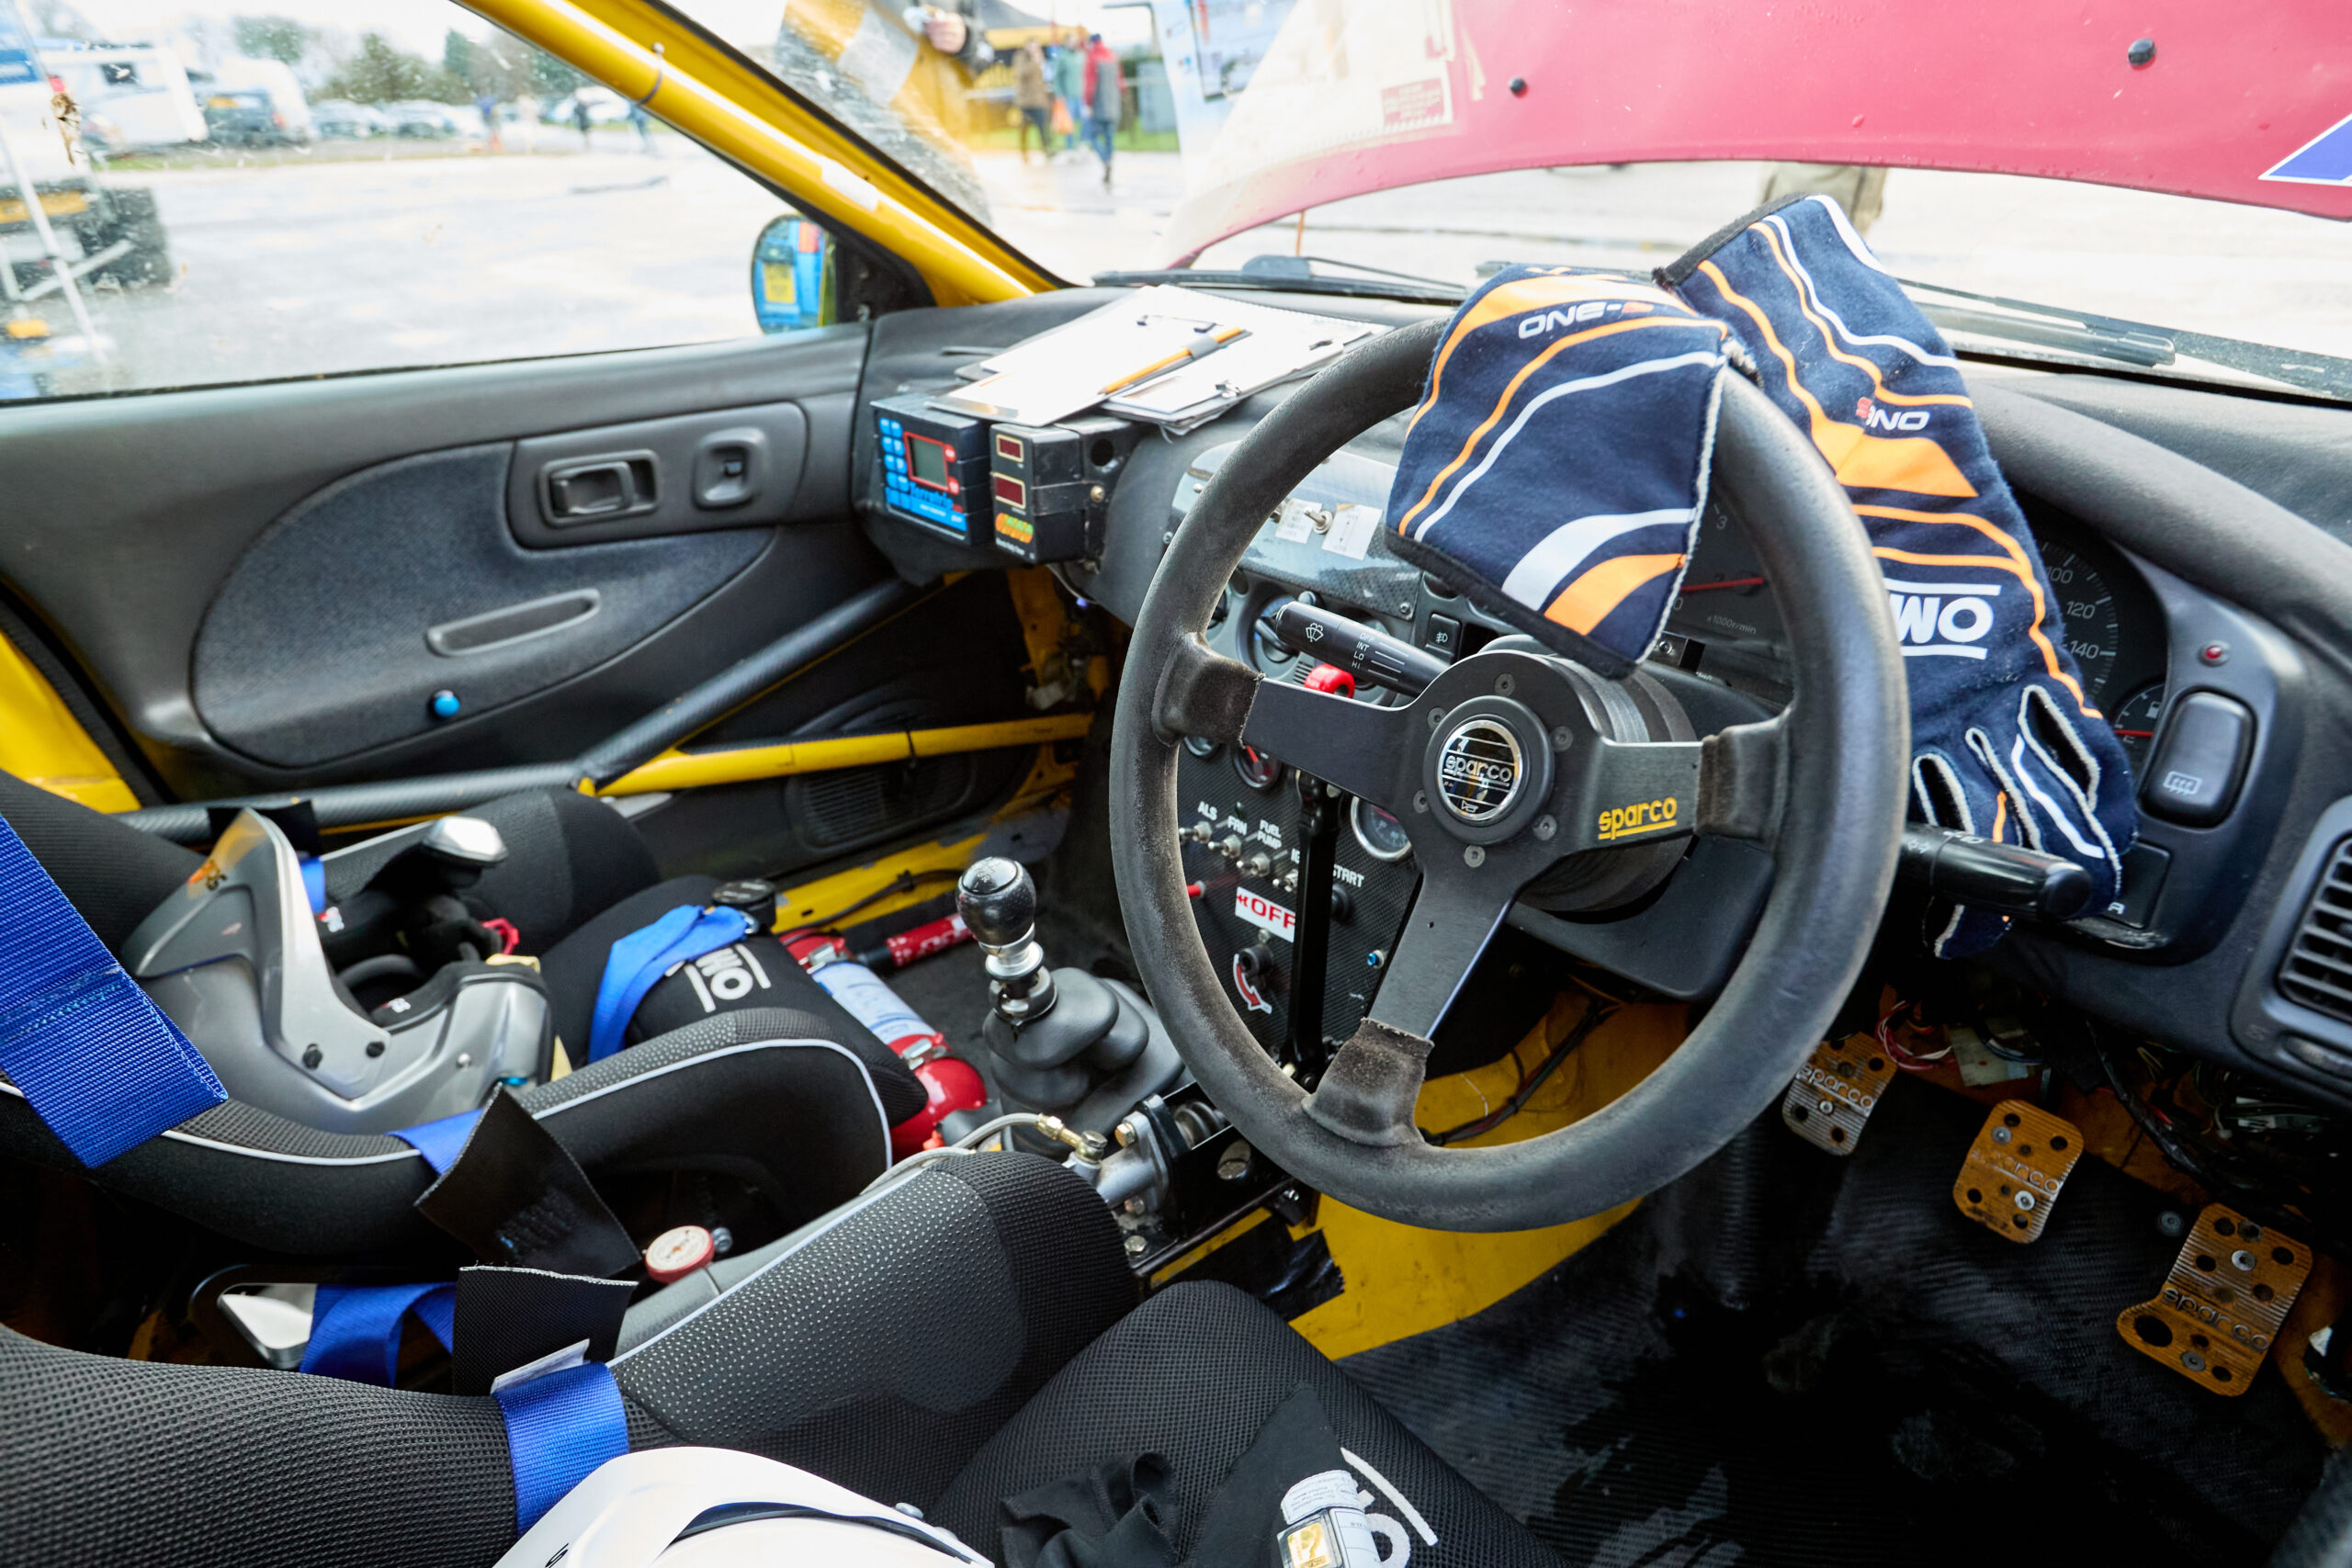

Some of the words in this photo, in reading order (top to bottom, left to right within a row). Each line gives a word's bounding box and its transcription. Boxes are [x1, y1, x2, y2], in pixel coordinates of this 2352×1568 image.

[1889, 593, 1995, 644] OM
[2066, 600, 2096, 620] 120
[1353, 650, 1364, 661] LO
[1356, 641, 1370, 652] INT
[2069, 639, 2100, 660] 140
[1351, 660, 1361, 670] HI
[1445, 755, 1513, 783] sparco
[1197, 801, 1218, 821] ALS
[1598, 795, 1678, 840] sparco
[1227, 815, 1248, 836] FAN
[1260, 819, 1282, 840] FUEL
[1257, 829, 1283, 851] PUMP
[1250, 897, 1296, 929] OFF
[1797, 1062, 1875, 1111] sparco
[2162, 1287, 2271, 1352] sparco
